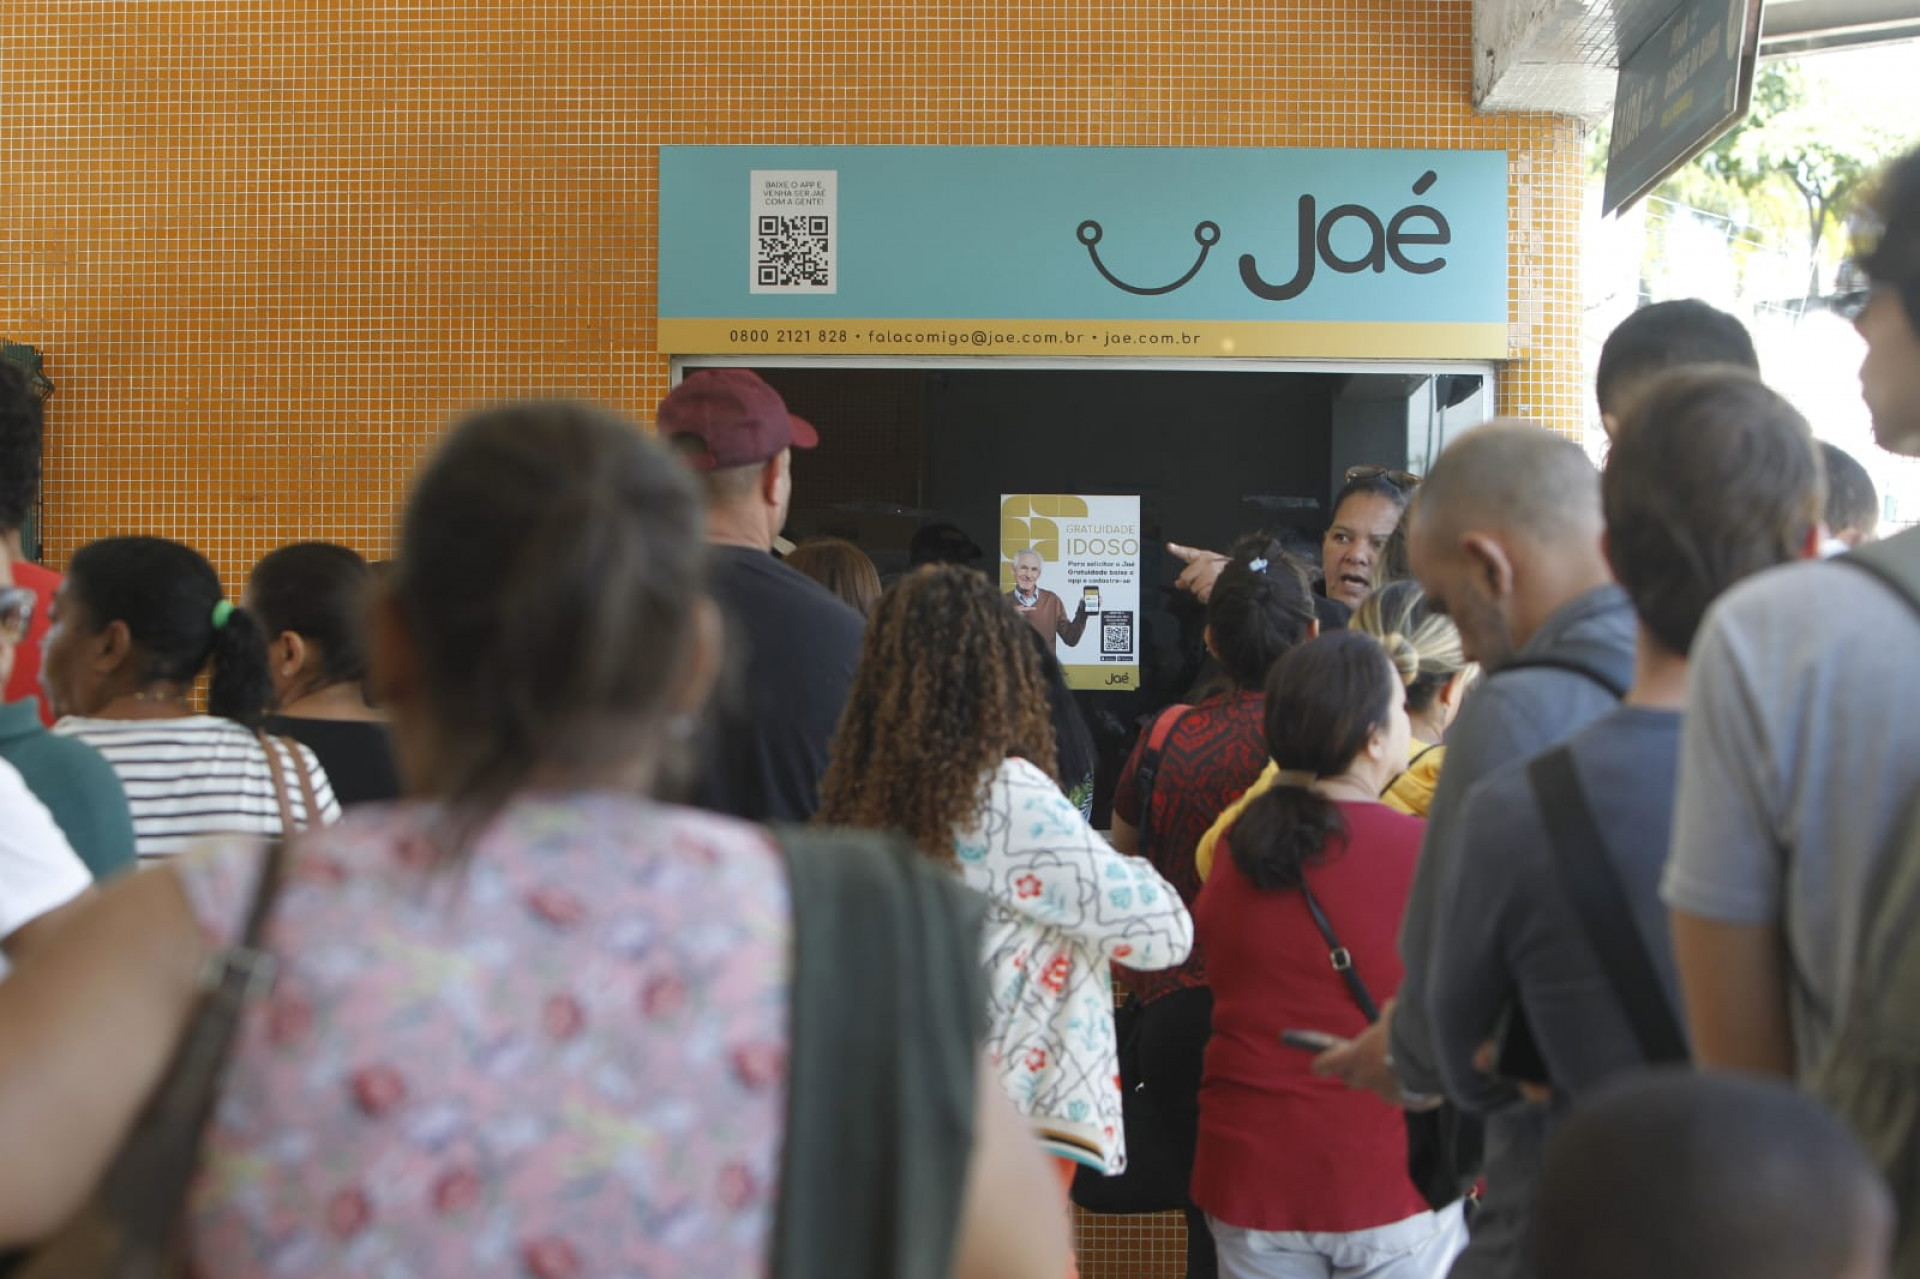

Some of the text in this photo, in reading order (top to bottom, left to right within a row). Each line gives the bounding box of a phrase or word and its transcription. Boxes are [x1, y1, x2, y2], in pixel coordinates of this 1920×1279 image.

[765, 181, 823, 189] BAIXE O APP E
[811, 188, 826, 197] JAÉ
[1239, 170, 1451, 301] Jaé
[730, 329, 1201, 348] 0800 2121 828 falacomigo@jae.com.br jae.com.br
[1066, 524, 1135, 534] GRATUIDADE
[1067, 538, 1138, 555] IDOSO
[1105, 672, 1129, 685] Jaé
